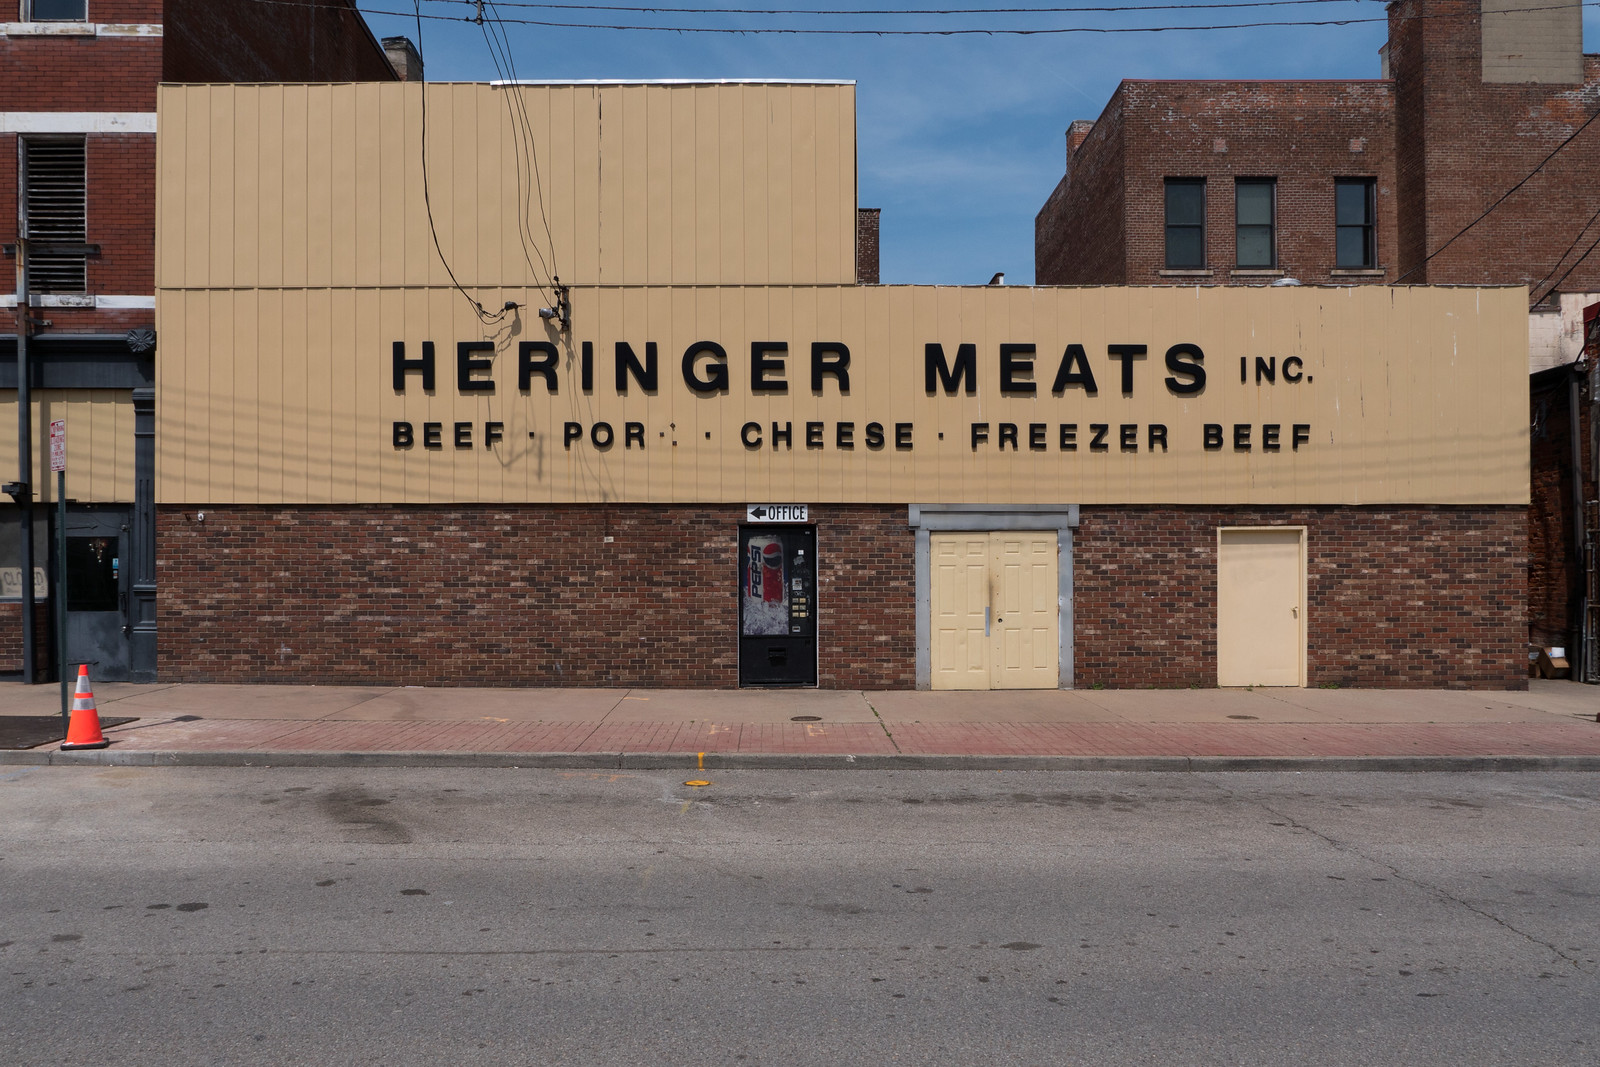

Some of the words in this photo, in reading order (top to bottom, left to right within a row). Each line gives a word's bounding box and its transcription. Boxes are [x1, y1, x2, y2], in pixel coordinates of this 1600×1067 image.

[392, 341, 850, 392] HERINGER
[925, 343, 1206, 394] MEATS
[1240, 356, 1313, 383] INC.
[392, 422, 504, 448] BEEF
[741, 422, 913, 449] CHEESE
[971, 423, 1168, 450] FREEZER
[1204, 423, 1311, 450] BEEF
[768, 505, 806, 520] OFFICE
[3, 571, 44, 586] CLOD
[751, 545, 763, 598] PEPSI
